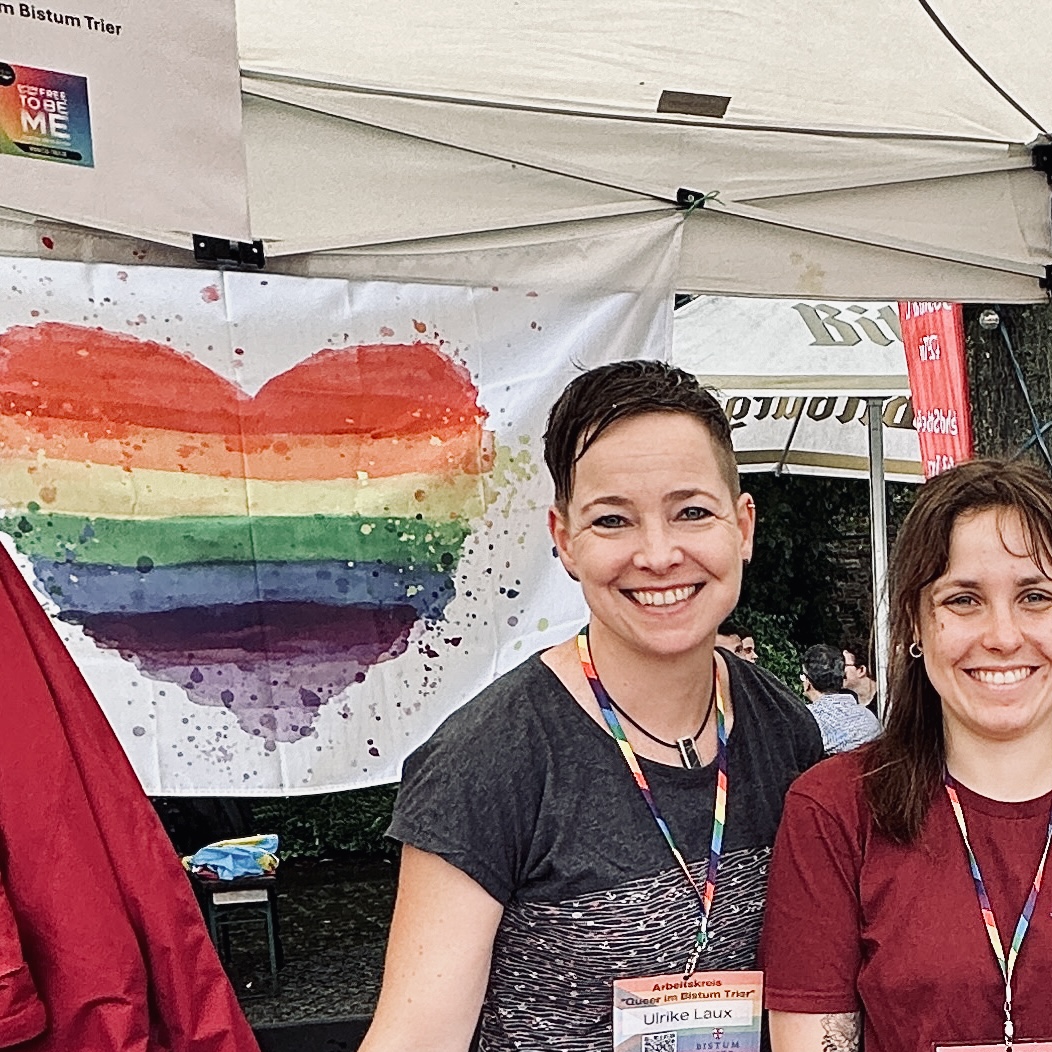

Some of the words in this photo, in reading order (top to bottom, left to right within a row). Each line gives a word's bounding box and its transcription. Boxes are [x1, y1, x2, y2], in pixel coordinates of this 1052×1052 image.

[0, 3, 14, 15] m
[19, 3, 81, 28] Bistum
[84, 16, 122, 35] Trier
[20, 110, 71, 139] ME
[652, 979, 723, 992] Arbeitskreis
[663, 994, 678, 1003] im
[681, 991, 721, 1000] Bistum
[644, 1010, 690, 1025] Ulrike
[694, 1008, 732, 1020] Laux
[696, 1041, 740, 1050] BISTUM
